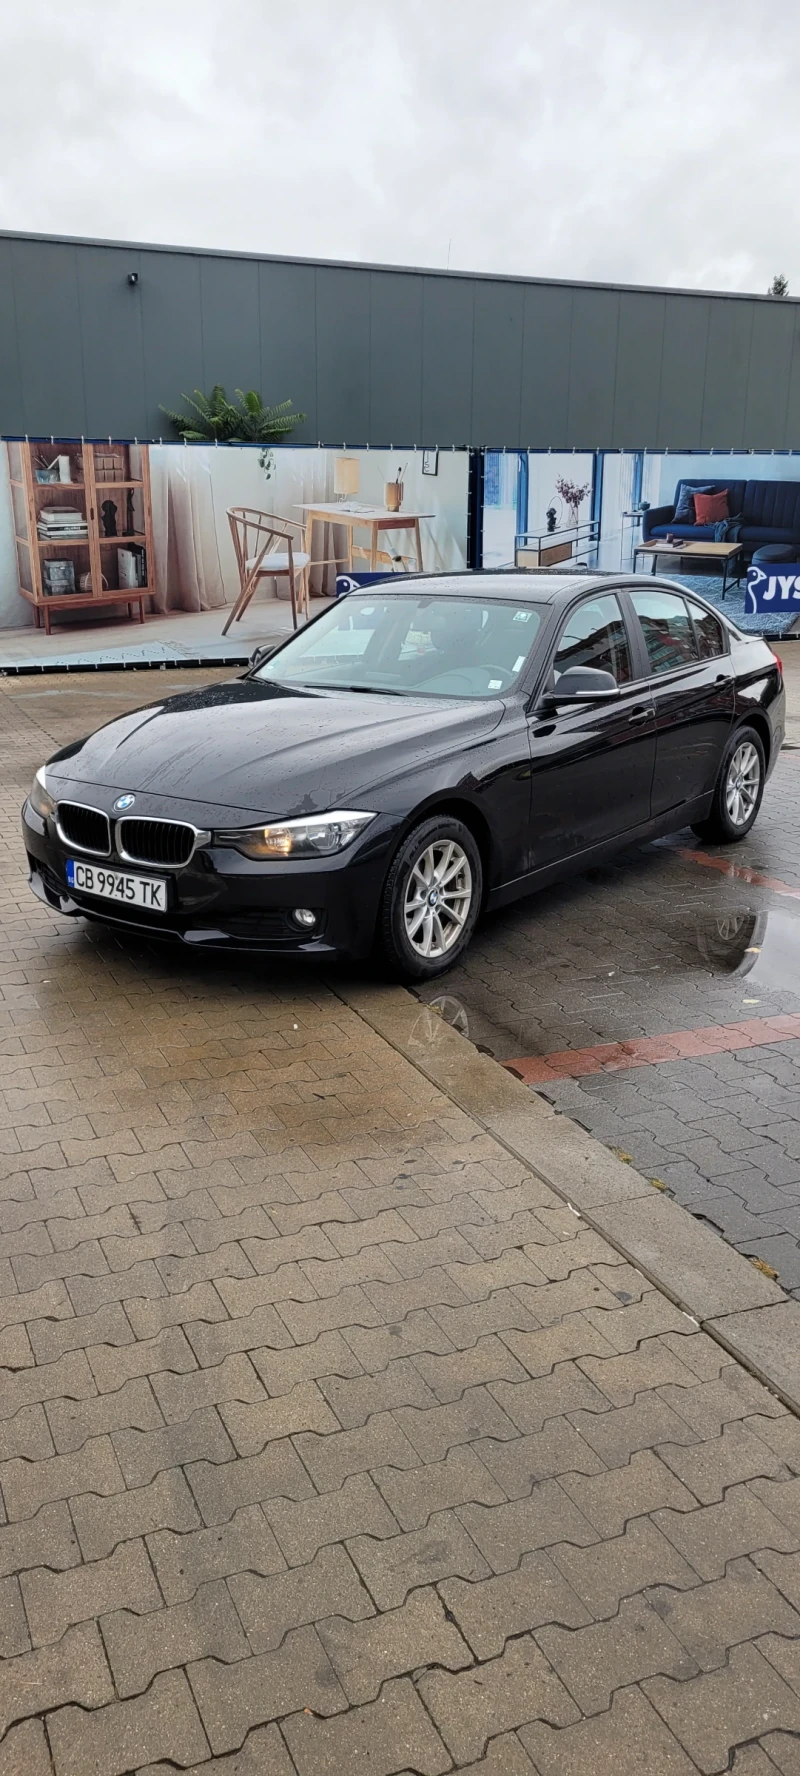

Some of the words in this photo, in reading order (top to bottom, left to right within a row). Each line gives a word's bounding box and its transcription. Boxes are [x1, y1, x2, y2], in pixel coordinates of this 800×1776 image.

[76, 866, 94, 889] CB
[97, 872, 135, 900] 9945
[139, 881, 162, 907] TK
